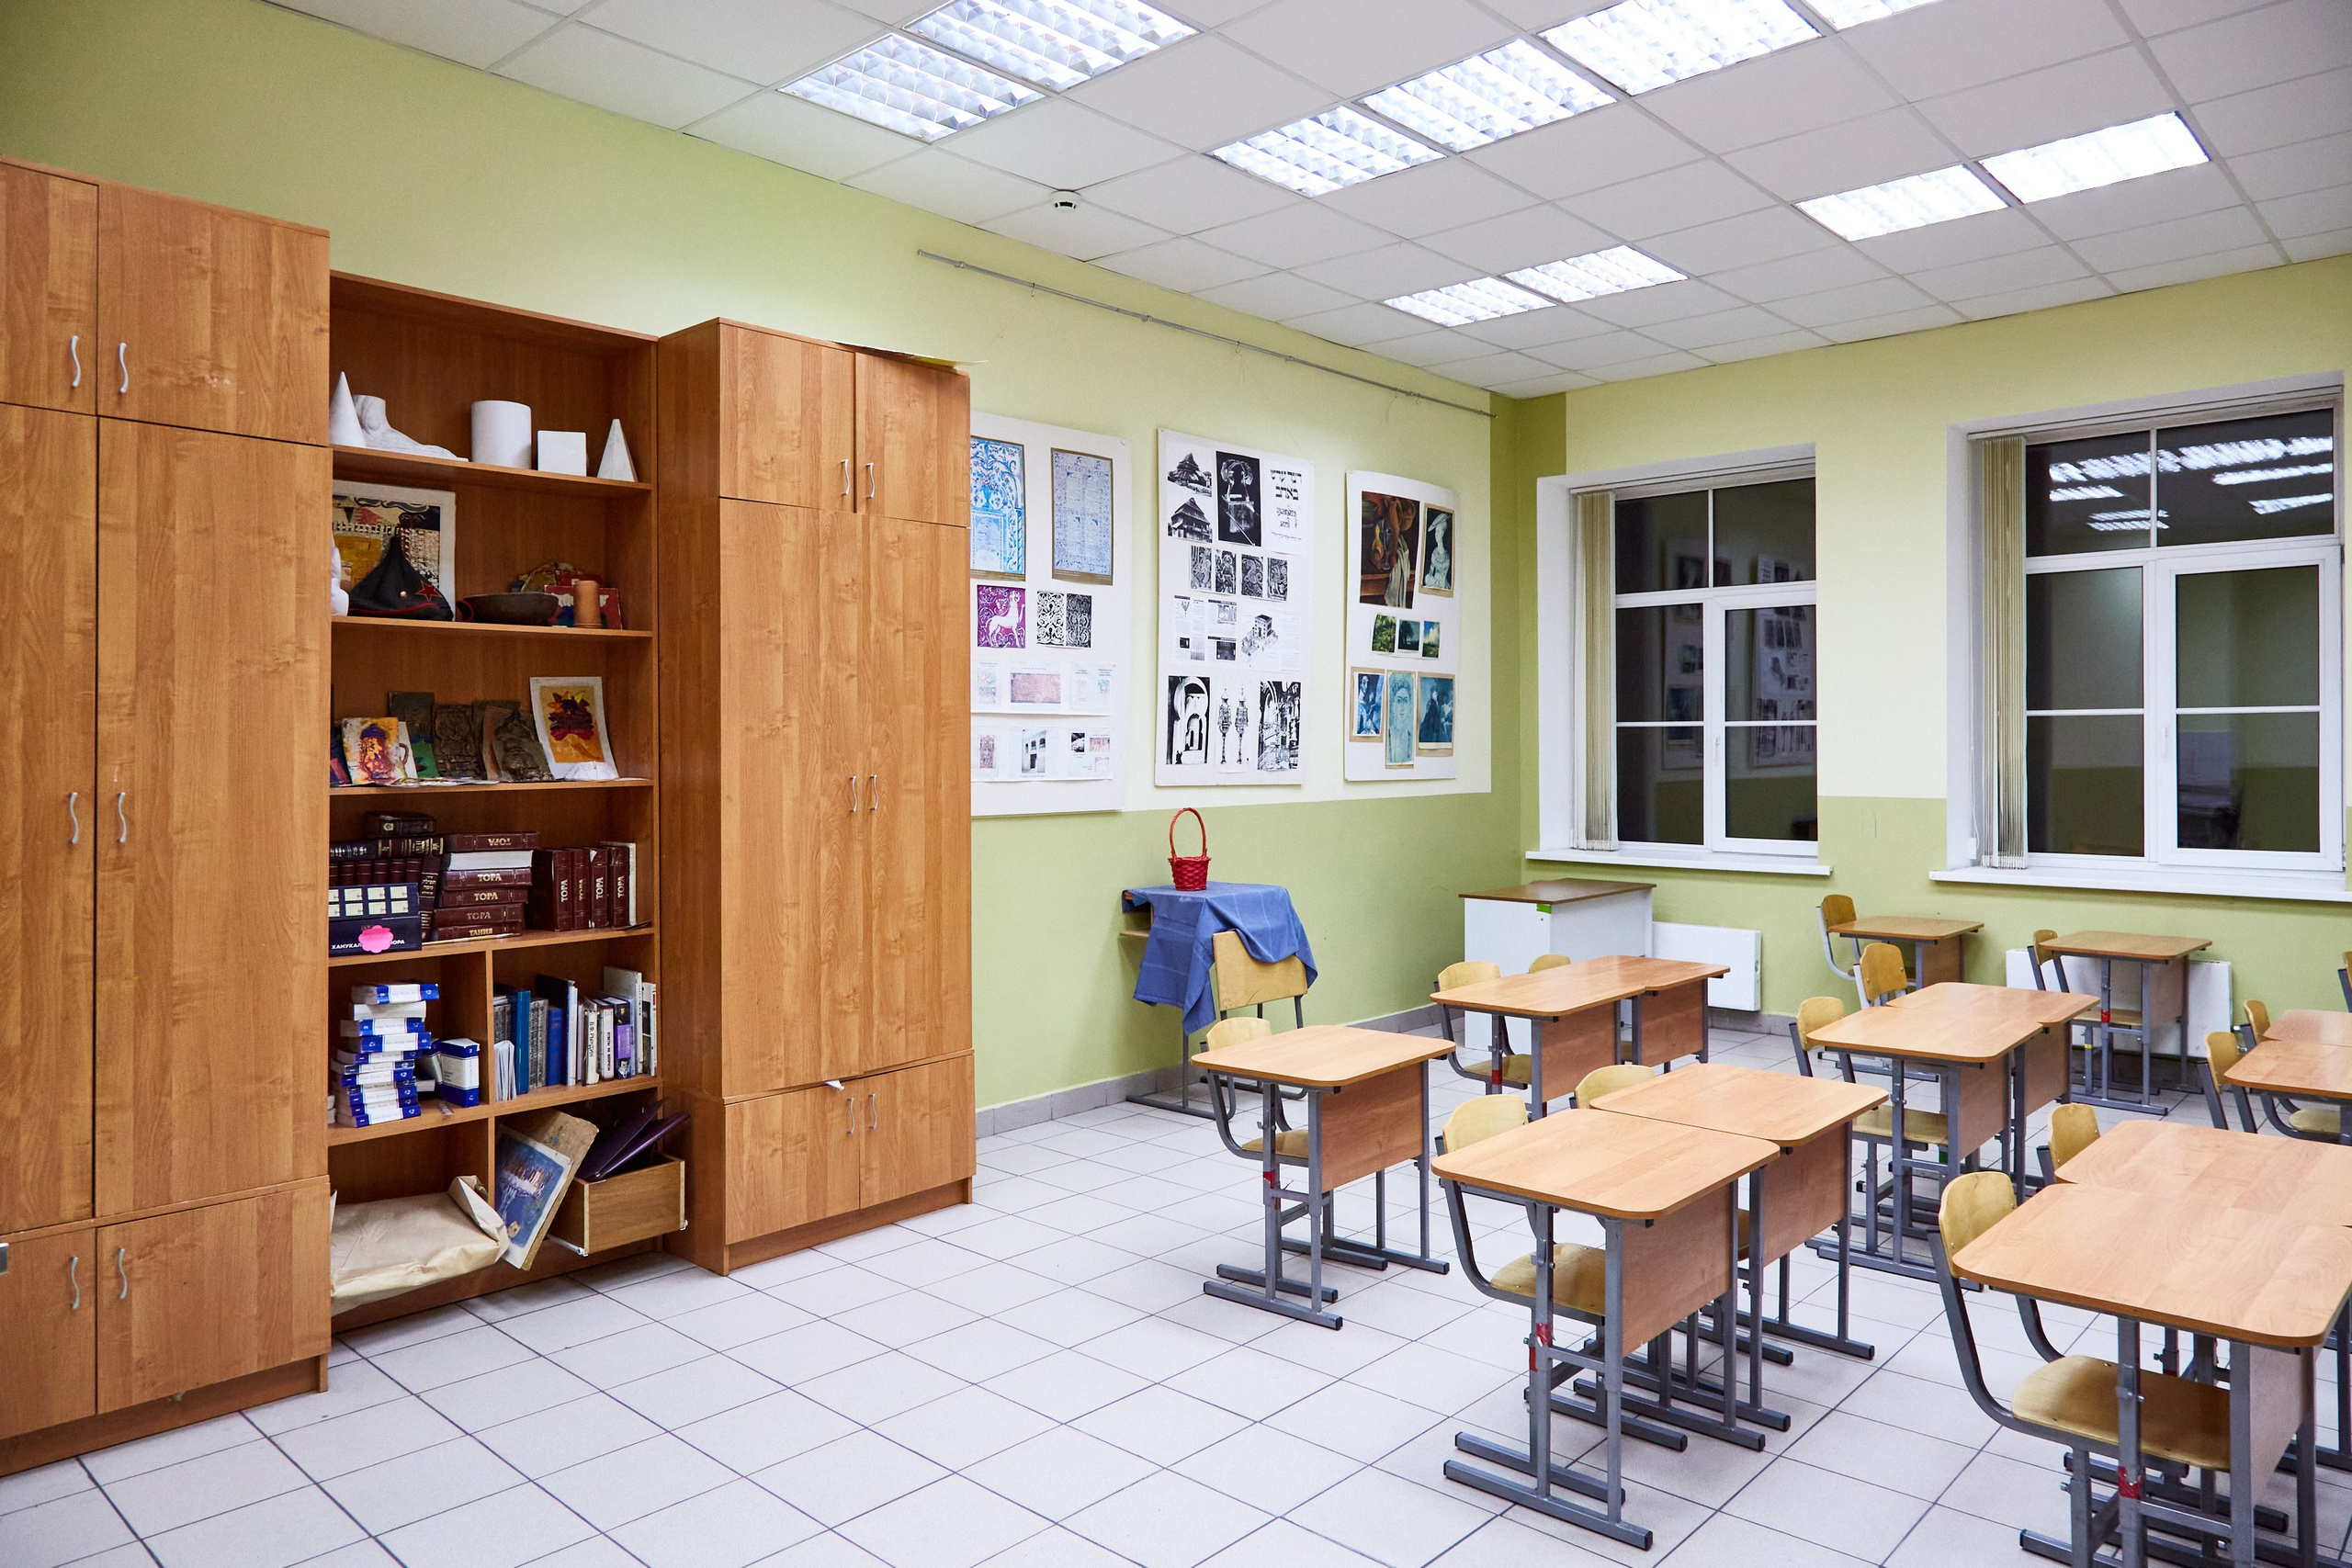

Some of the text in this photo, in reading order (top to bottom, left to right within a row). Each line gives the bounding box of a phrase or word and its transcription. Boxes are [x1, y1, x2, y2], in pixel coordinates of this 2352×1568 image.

[488, 838, 512, 846] ТОРА
[477, 873, 503, 882] ТОРА
[560, 878, 569, 903] ТОРА
[595, 876, 604, 900] ТОРА
[474, 892, 499, 901] ТОРА
[467, 911, 492, 920] ТОРА
